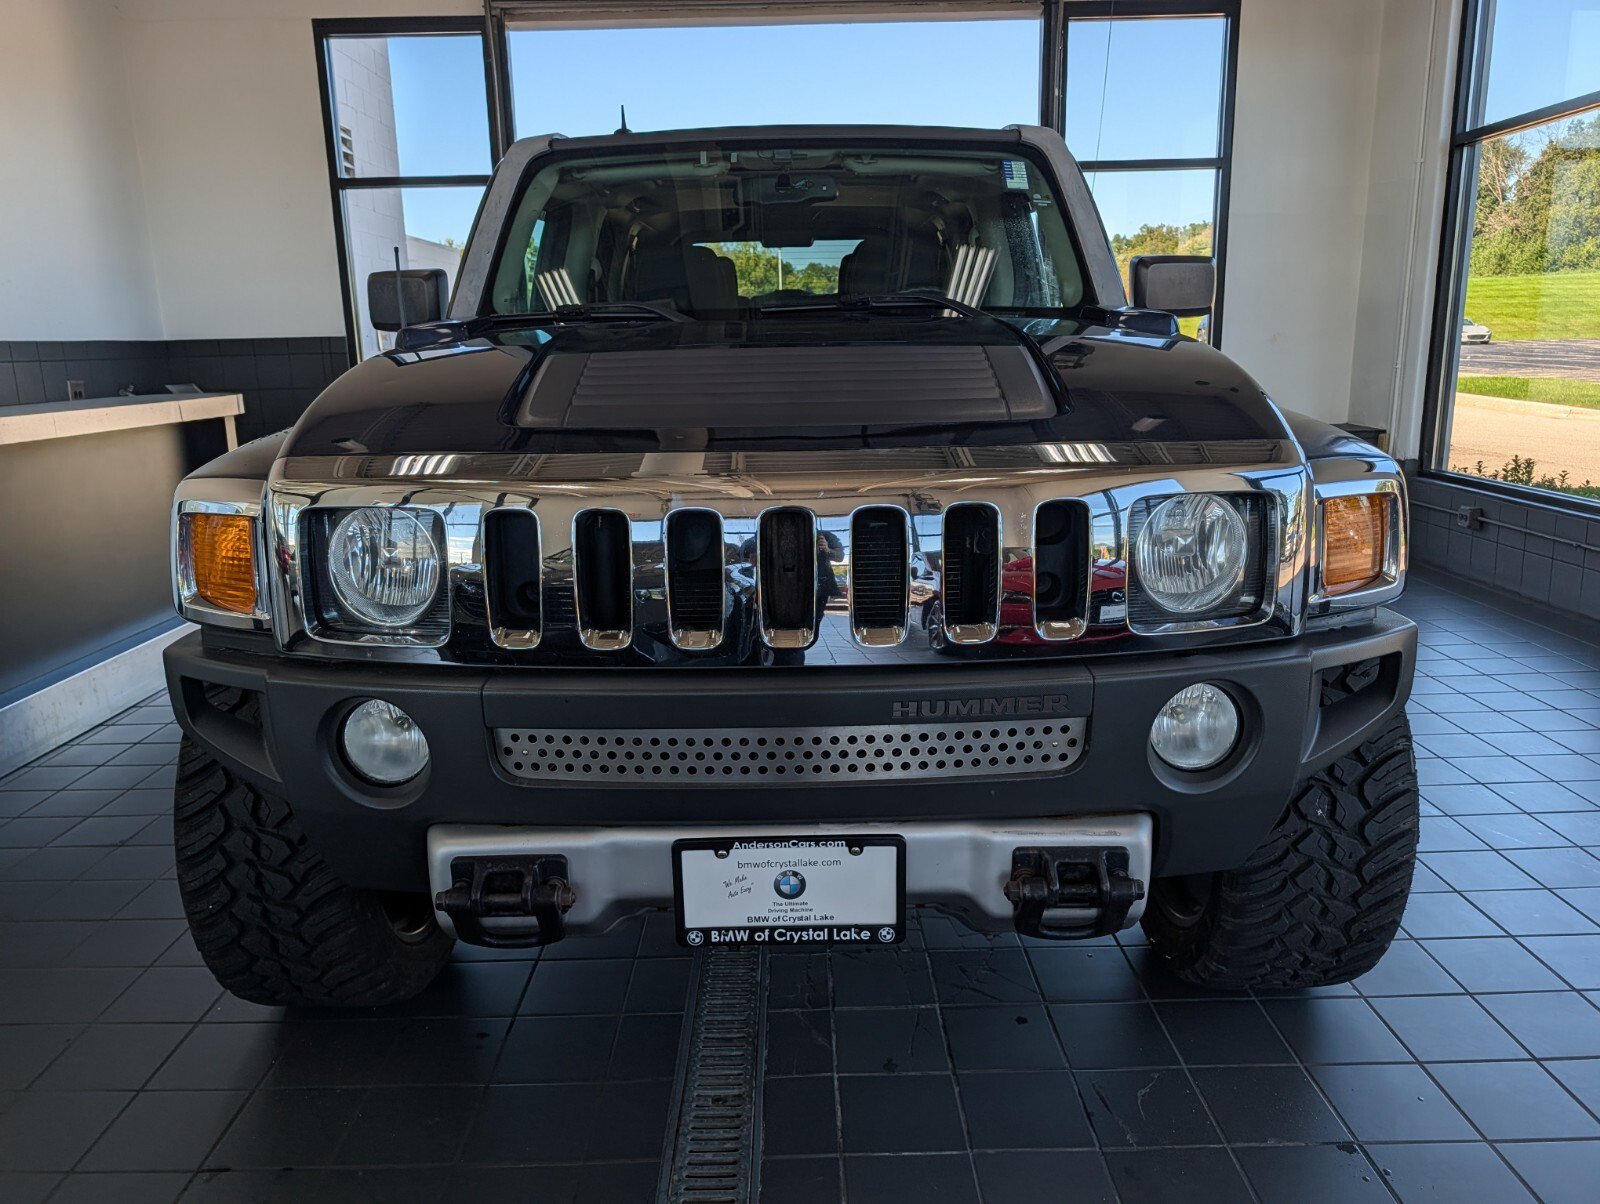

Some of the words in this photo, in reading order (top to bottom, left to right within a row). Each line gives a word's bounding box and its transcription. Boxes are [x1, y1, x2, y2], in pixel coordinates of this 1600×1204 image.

[892, 694, 1070, 718] HUMMER
[732, 840, 847, 849] AndersonCars.com
[737, 859, 842, 869] bmwofcrystallake.com
[776, 870, 804, 880] BMW
[747, 915, 770, 923] BMW
[772, 915, 781, 923] of
[782, 914, 812, 924] Crystal
[711, 929, 749, 942] BMW
[754, 928, 769, 941] of
[774, 927, 829, 943] Crystal
[833, 927, 871, 941] Lake
